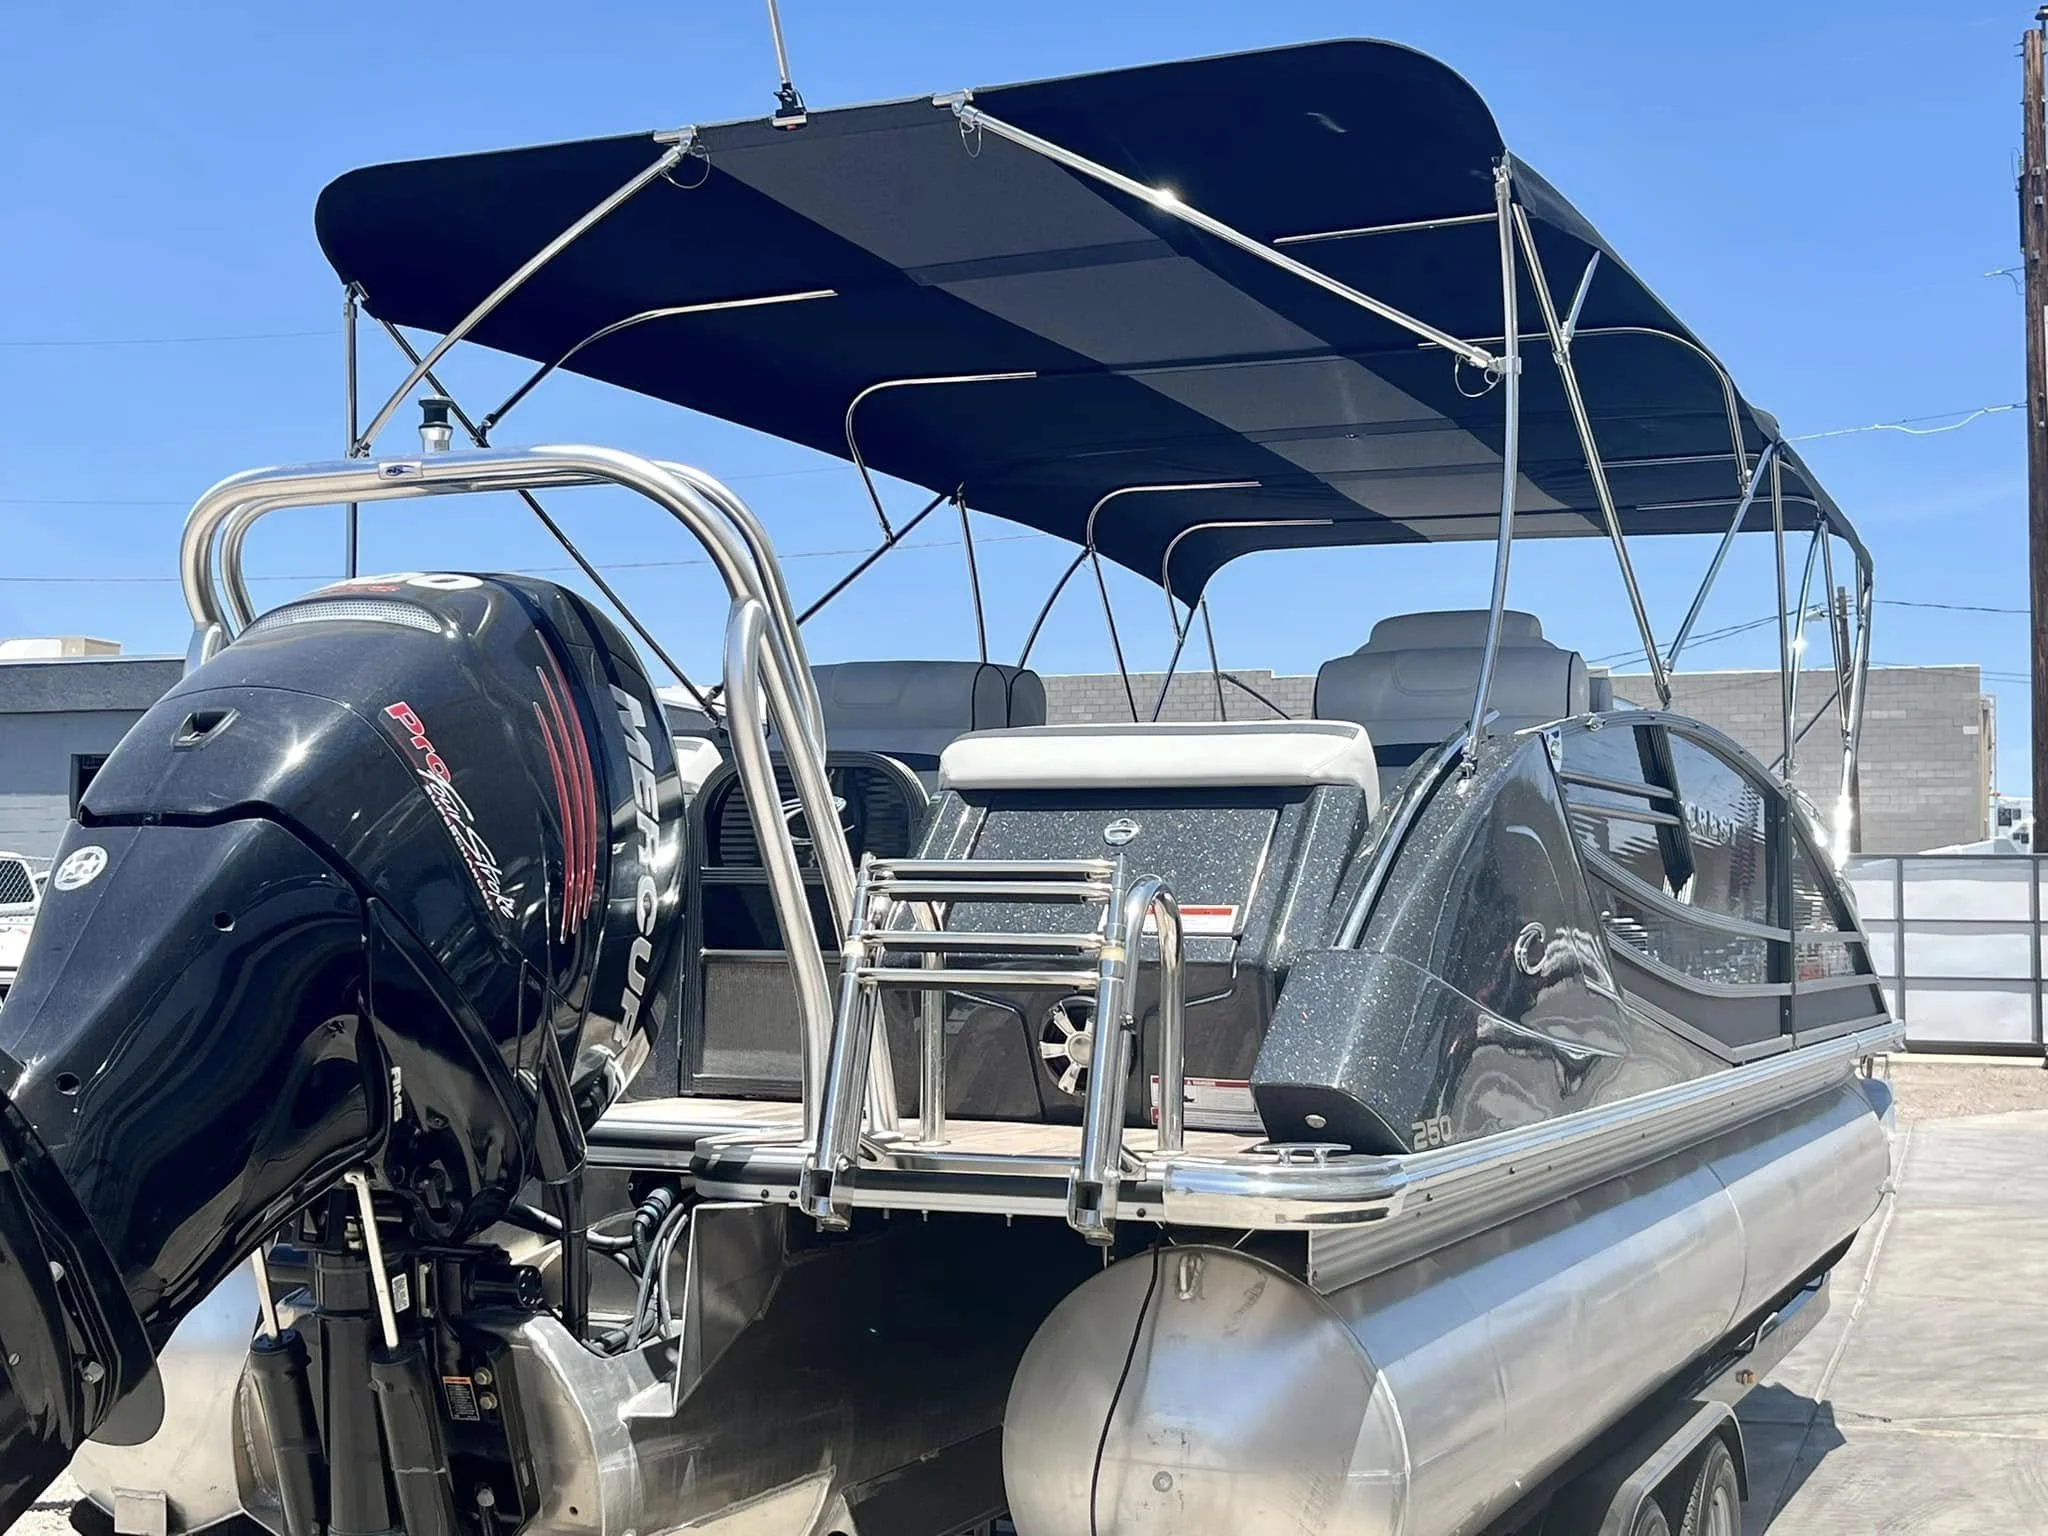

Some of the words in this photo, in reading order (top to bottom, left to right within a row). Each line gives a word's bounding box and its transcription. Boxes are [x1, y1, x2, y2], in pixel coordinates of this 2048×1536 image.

[384, 701, 452, 783] Pro
[608, 683, 659, 1050] MERCUR
[1411, 1115, 1452, 1150] 250
